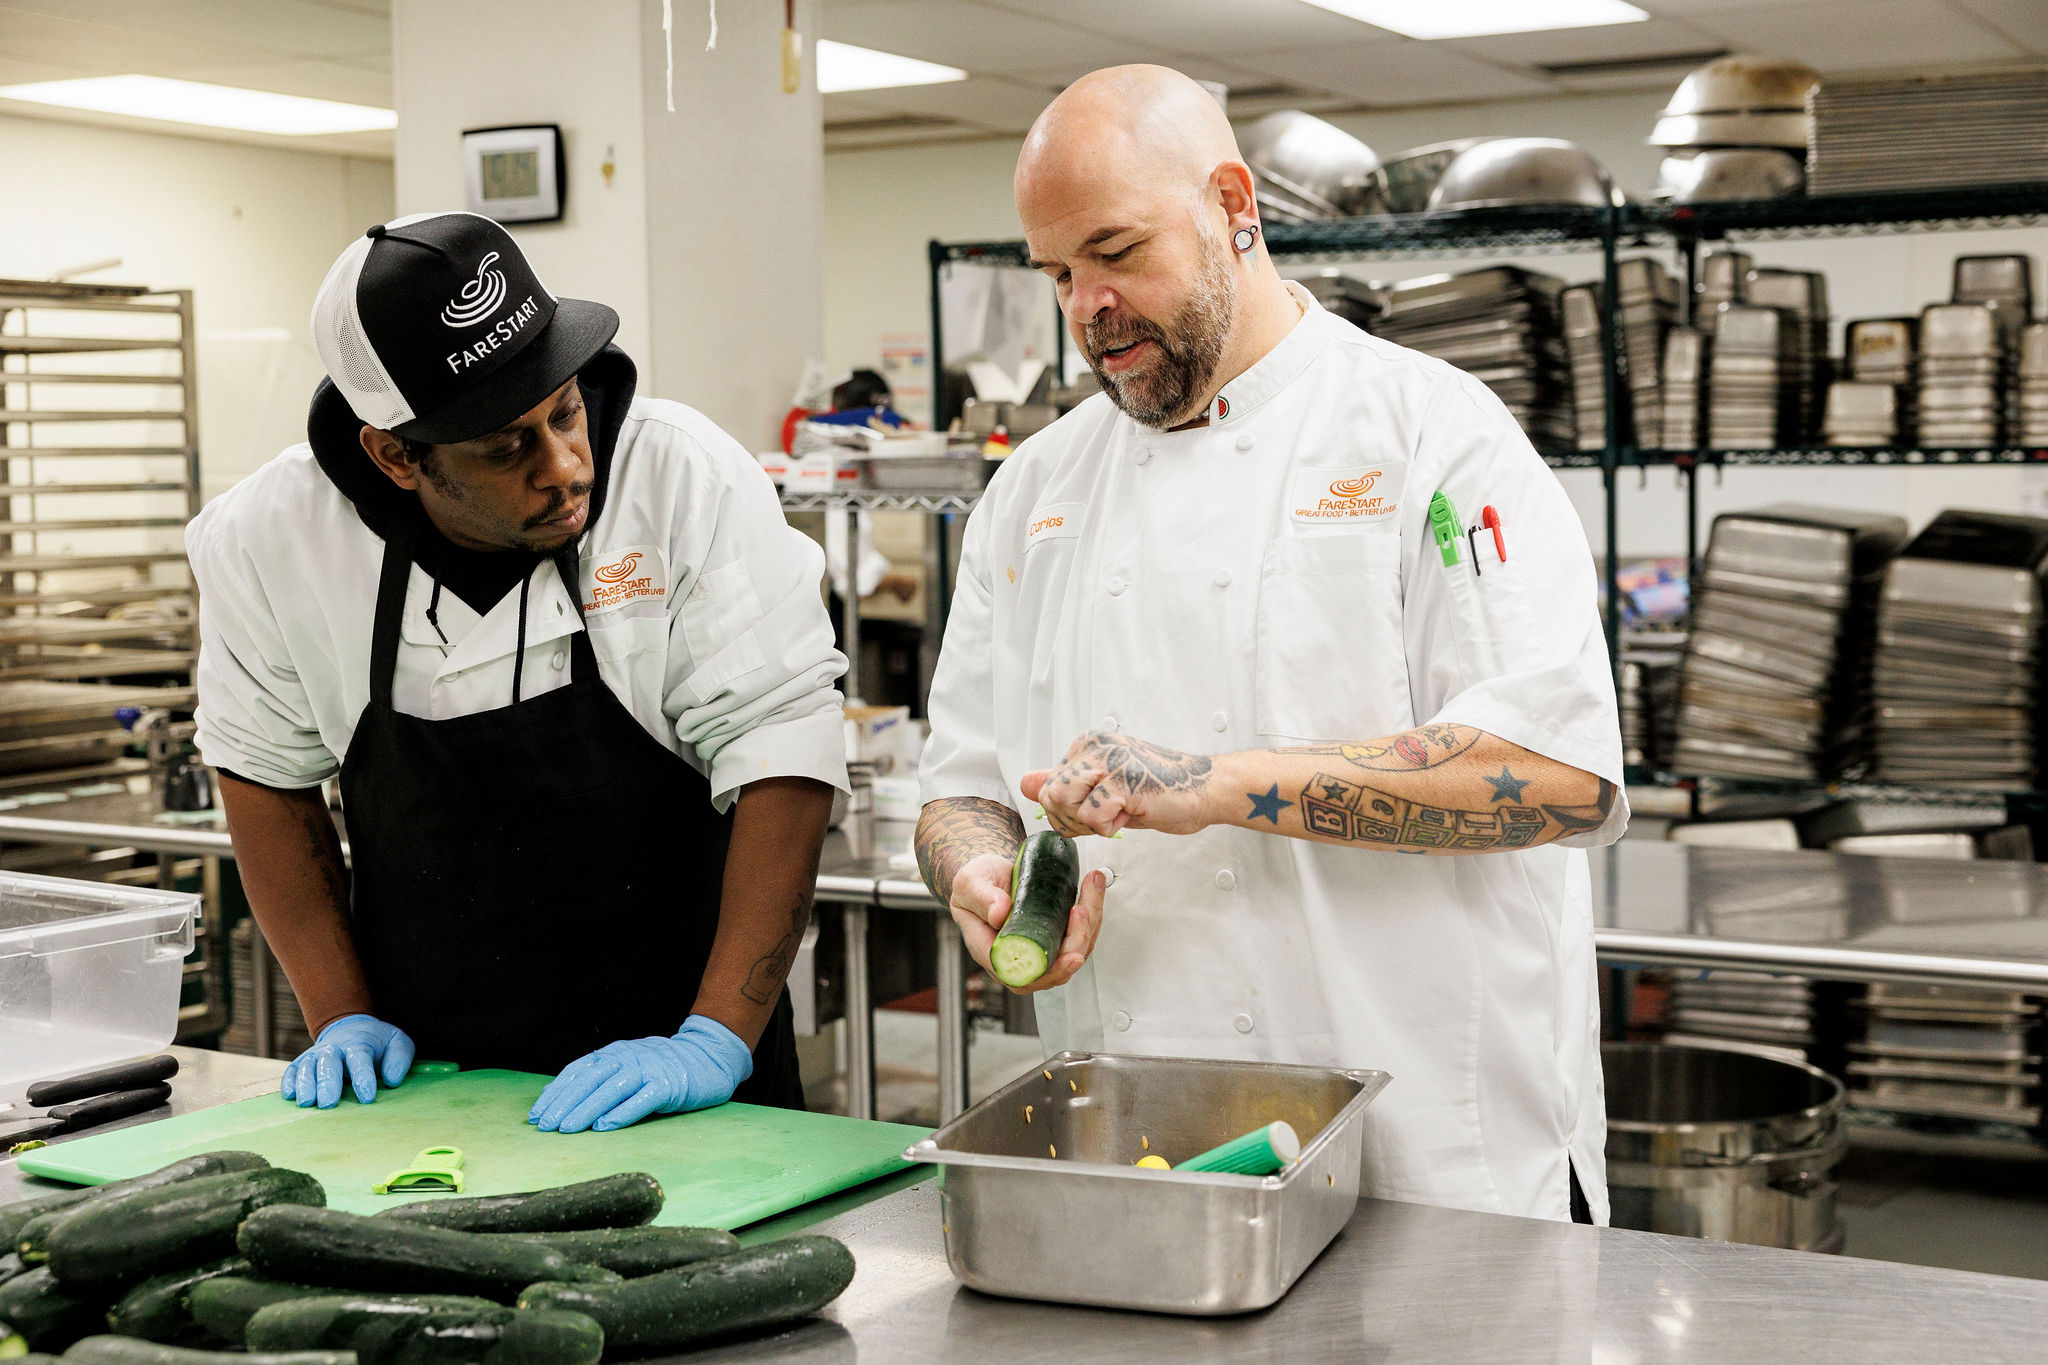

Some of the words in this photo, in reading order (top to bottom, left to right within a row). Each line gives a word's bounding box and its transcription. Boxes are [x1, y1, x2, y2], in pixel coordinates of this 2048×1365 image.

[1295, 508, 1321, 517] GREAT
[1322, 509, 1344, 518] FOOD
[1349, 508, 1379, 517] BETTER
[1379, 504, 1397, 515] LIVES
[583, 601, 601, 612] REAT
[602, 596, 621, 608] FOOD
[624, 588, 650, 600] BETTER
[650, 588, 665, 596] LIVES
